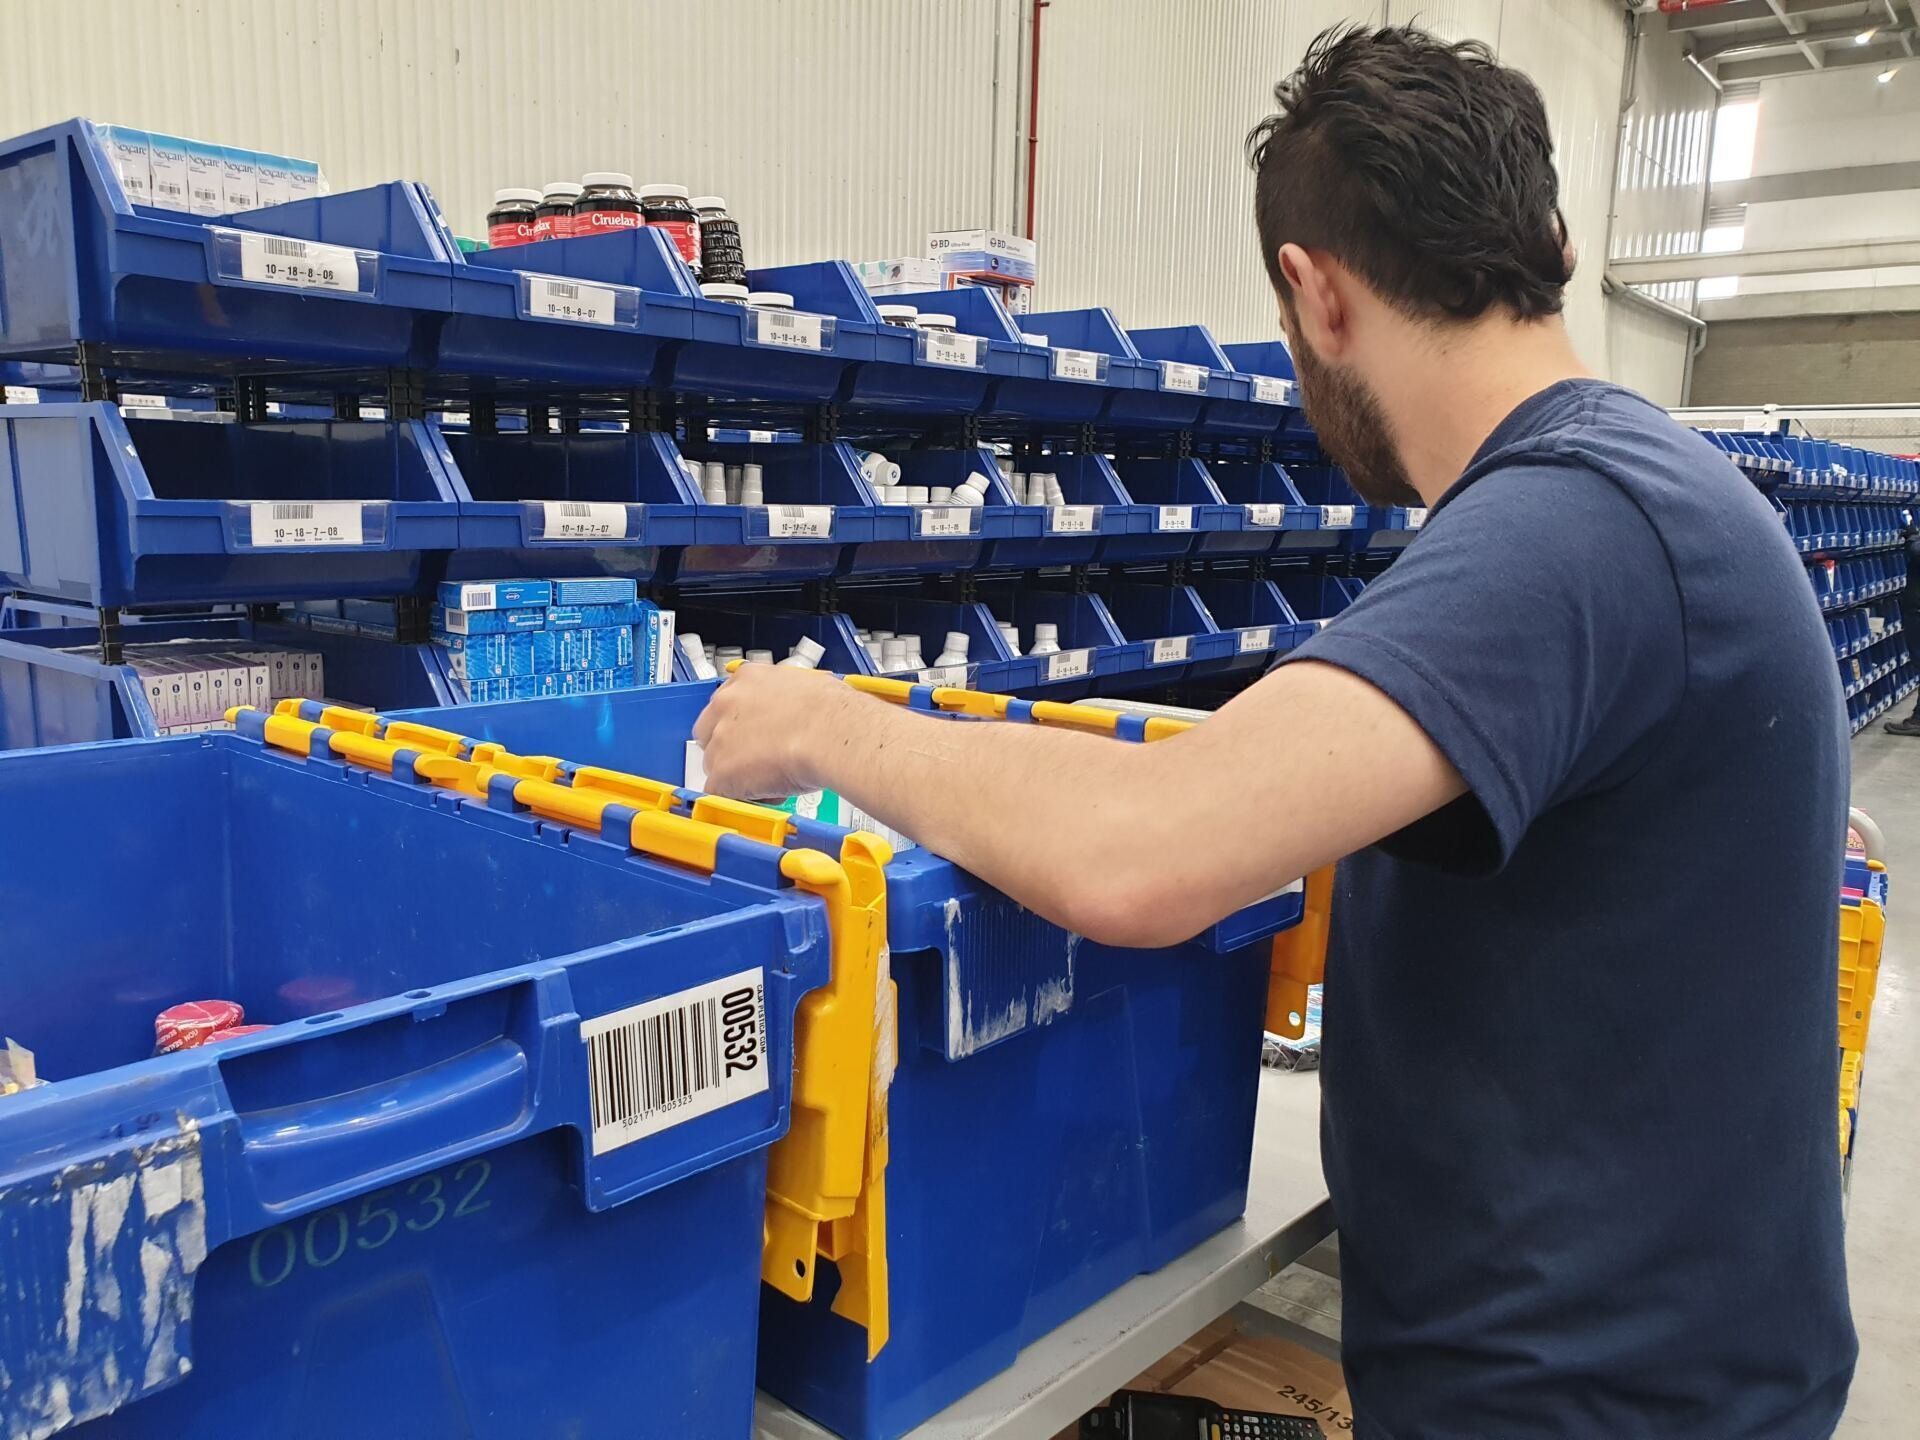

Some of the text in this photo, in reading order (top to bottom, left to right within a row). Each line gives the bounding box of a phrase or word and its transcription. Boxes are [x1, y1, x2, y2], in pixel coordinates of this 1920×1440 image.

[152, 148, 185, 162] Nexcare
[189, 154, 220, 168] Nexcare
[223, 160, 254, 174] Nexcare
[592, 213, 635, 227] Ciruelax
[939, 239, 950, 248] BD
[997, 239, 1006, 249] BD
[274, 527, 338, 538] 10-18-7-08
[561, 524, 609, 533] 10-18-7-07
[721, 987, 758, 1078] 00532
[622, 1094, 693, 1128] 502171 005323
[249, 1159, 492, 1287] 00532
[1276, 1385, 1353, 1431] 245/13
